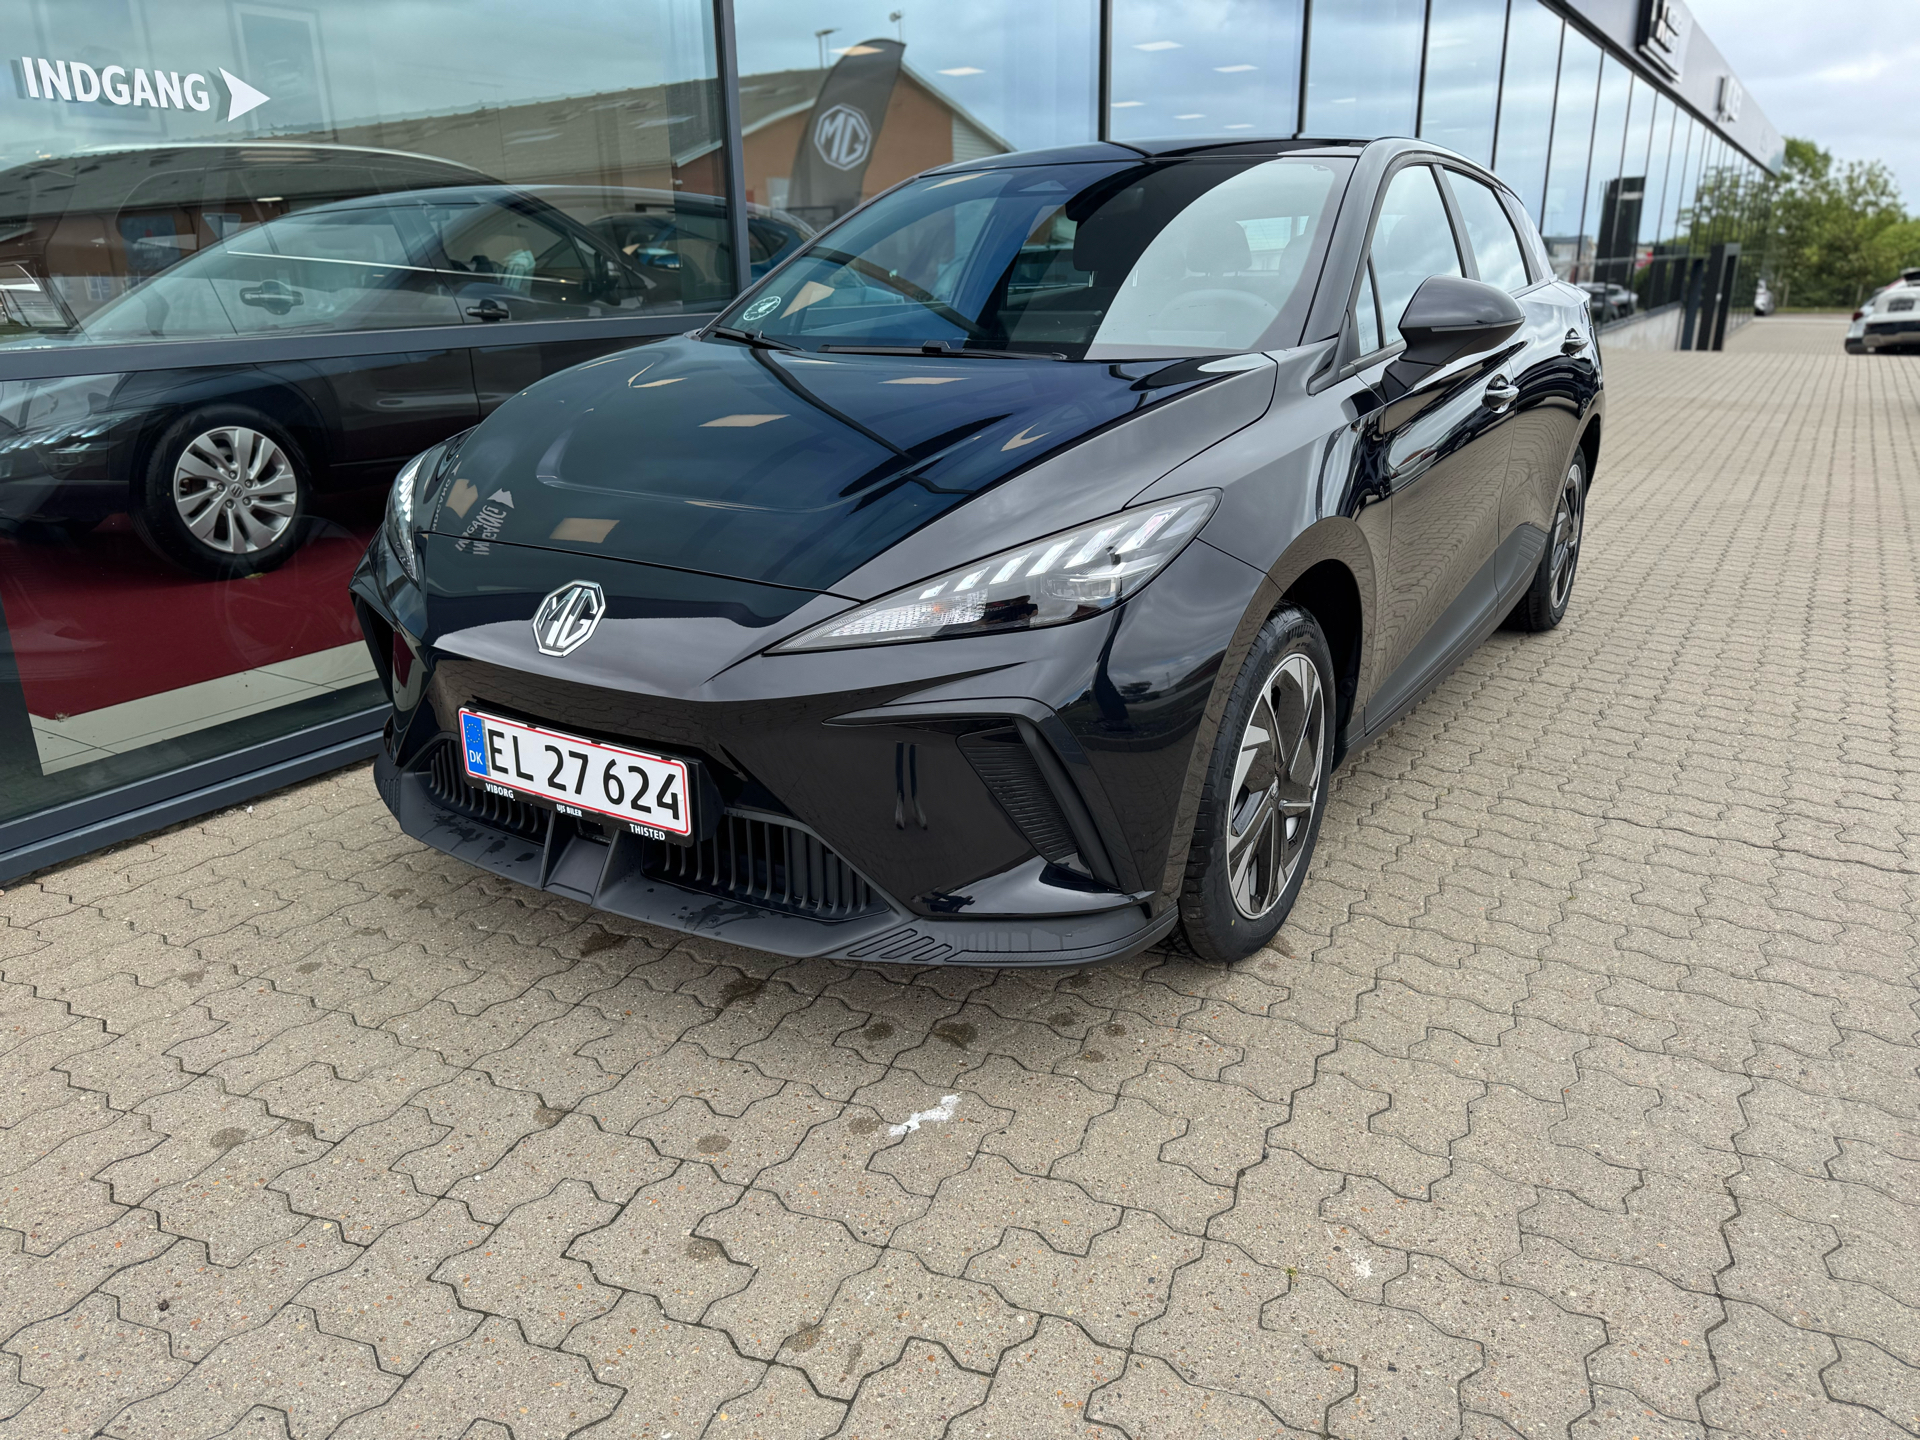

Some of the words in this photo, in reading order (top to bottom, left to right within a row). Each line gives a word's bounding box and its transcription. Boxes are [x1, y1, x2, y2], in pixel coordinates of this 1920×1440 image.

[21, 56, 211, 112] INDGANG
[818, 110, 867, 166] MG
[537, 587, 599, 648] MG
[468, 749, 483, 766] DK
[487, 728, 534, 782] EL
[544, 744, 589, 796] 27
[602, 758, 680, 821] 624
[485, 783, 514, 799] VIBORG
[629, 823, 666, 841] THISTED
